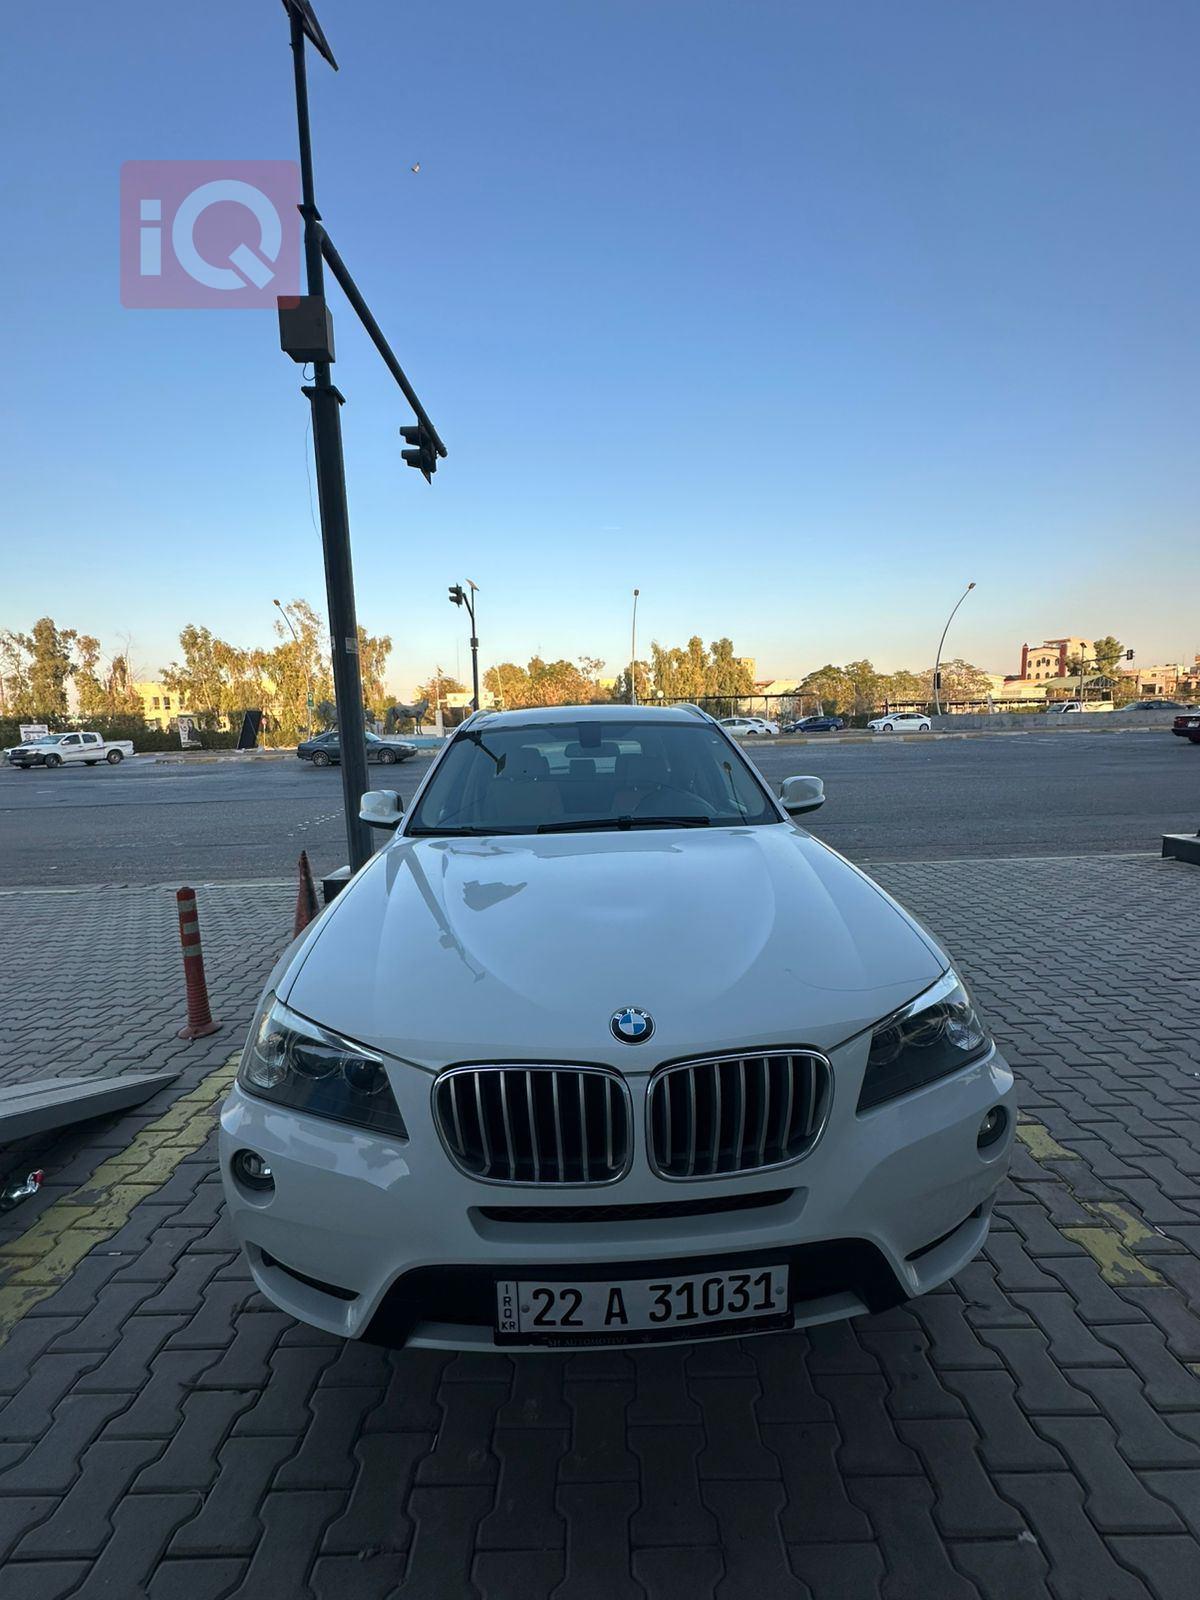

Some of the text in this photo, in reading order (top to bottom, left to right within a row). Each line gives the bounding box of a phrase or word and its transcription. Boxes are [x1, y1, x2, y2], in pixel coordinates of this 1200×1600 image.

[614, 1008, 649, 1020] BMW
[532, 1271, 776, 1326] 22 A 31031
[501, 1320, 516, 1331] KR
